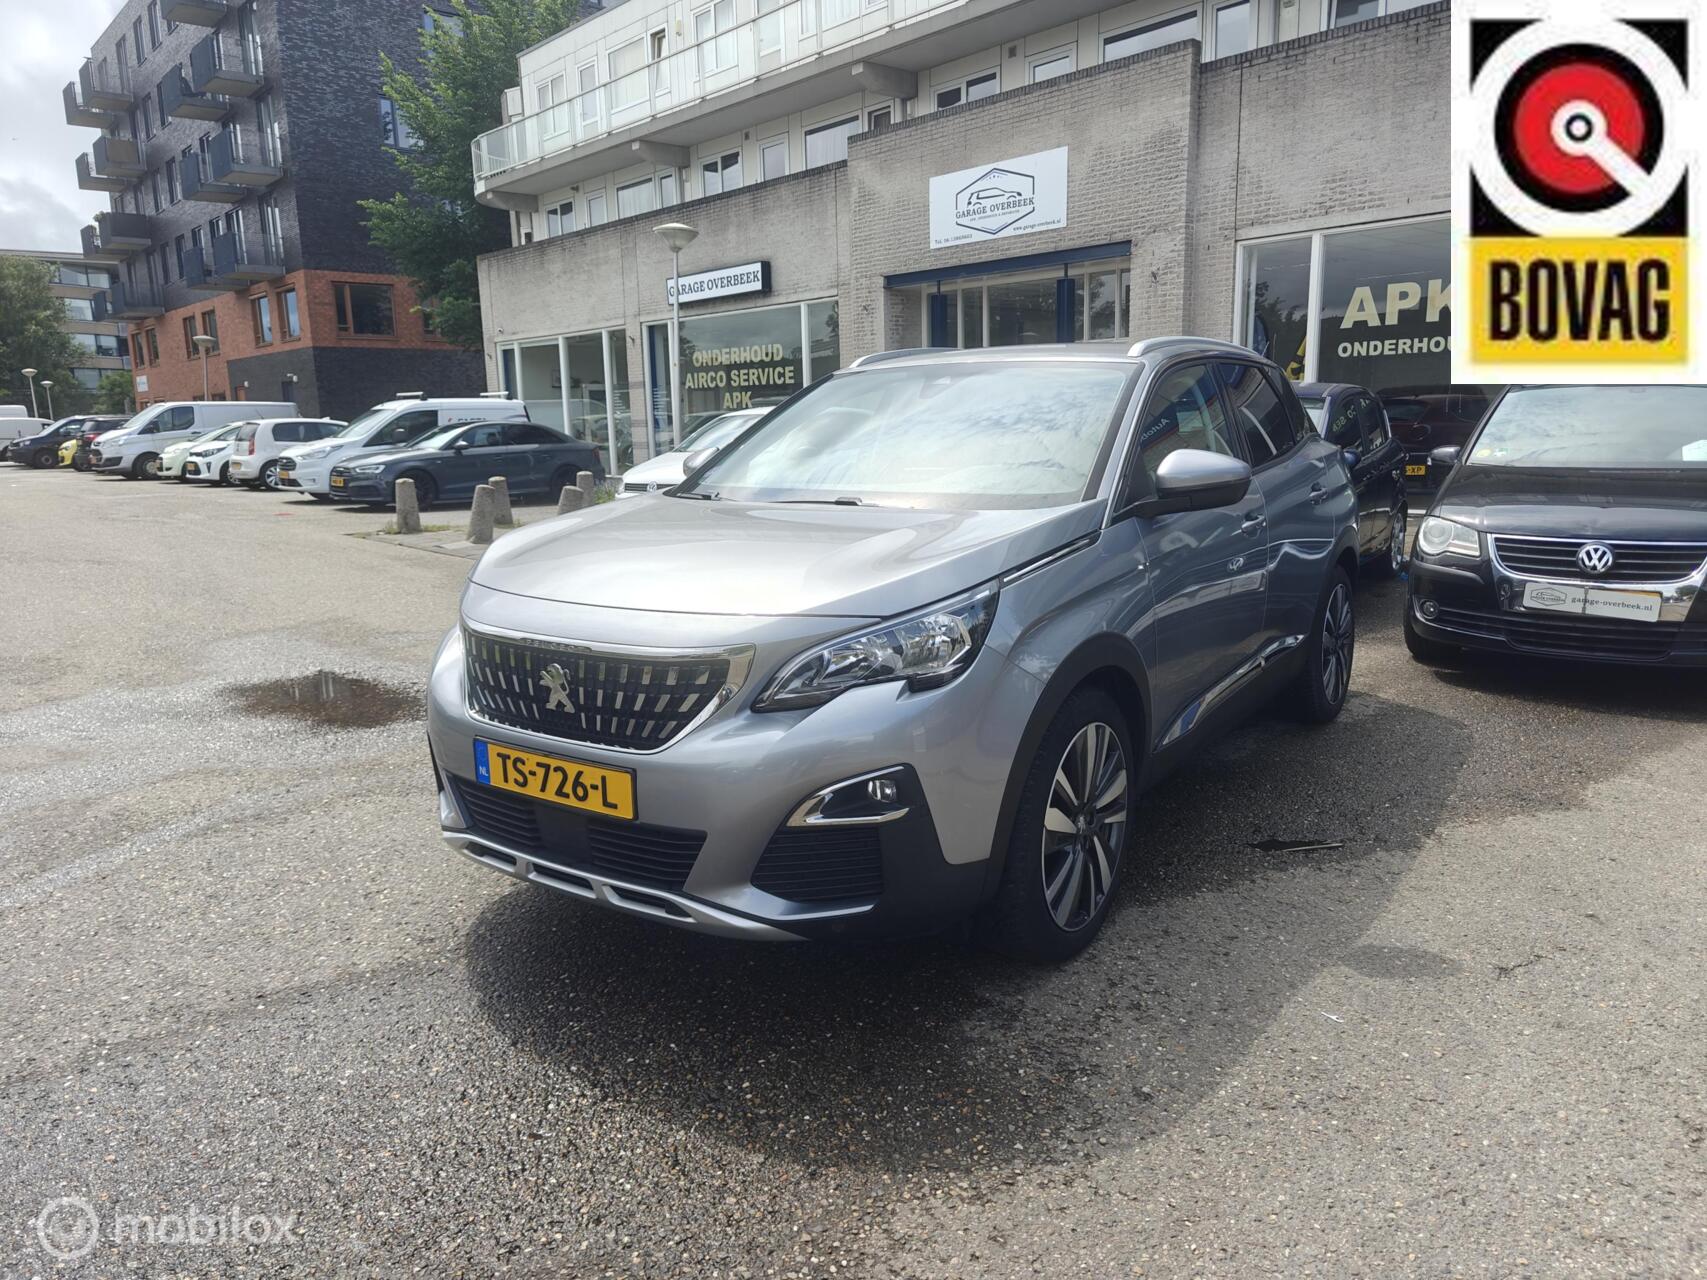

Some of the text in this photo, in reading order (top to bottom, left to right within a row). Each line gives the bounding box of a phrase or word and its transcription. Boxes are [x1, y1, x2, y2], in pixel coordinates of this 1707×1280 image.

[956, 205, 988, 219] GARAGE
[990, 196, 1035, 213] OVERBEEK
[669, 270, 760, 297] GARAGE OVERBEEK
[1339, 278, 1451, 329] APK
[692, 343, 783, 368] ONDERHOUD
[685, 366, 795, 389] AIRCO SERVICE
[723, 391, 752, 409] APK
[1571, 596, 1653, 611] garage-overbeek.nl
[479, 752, 618, 810] NL TS-726-L
